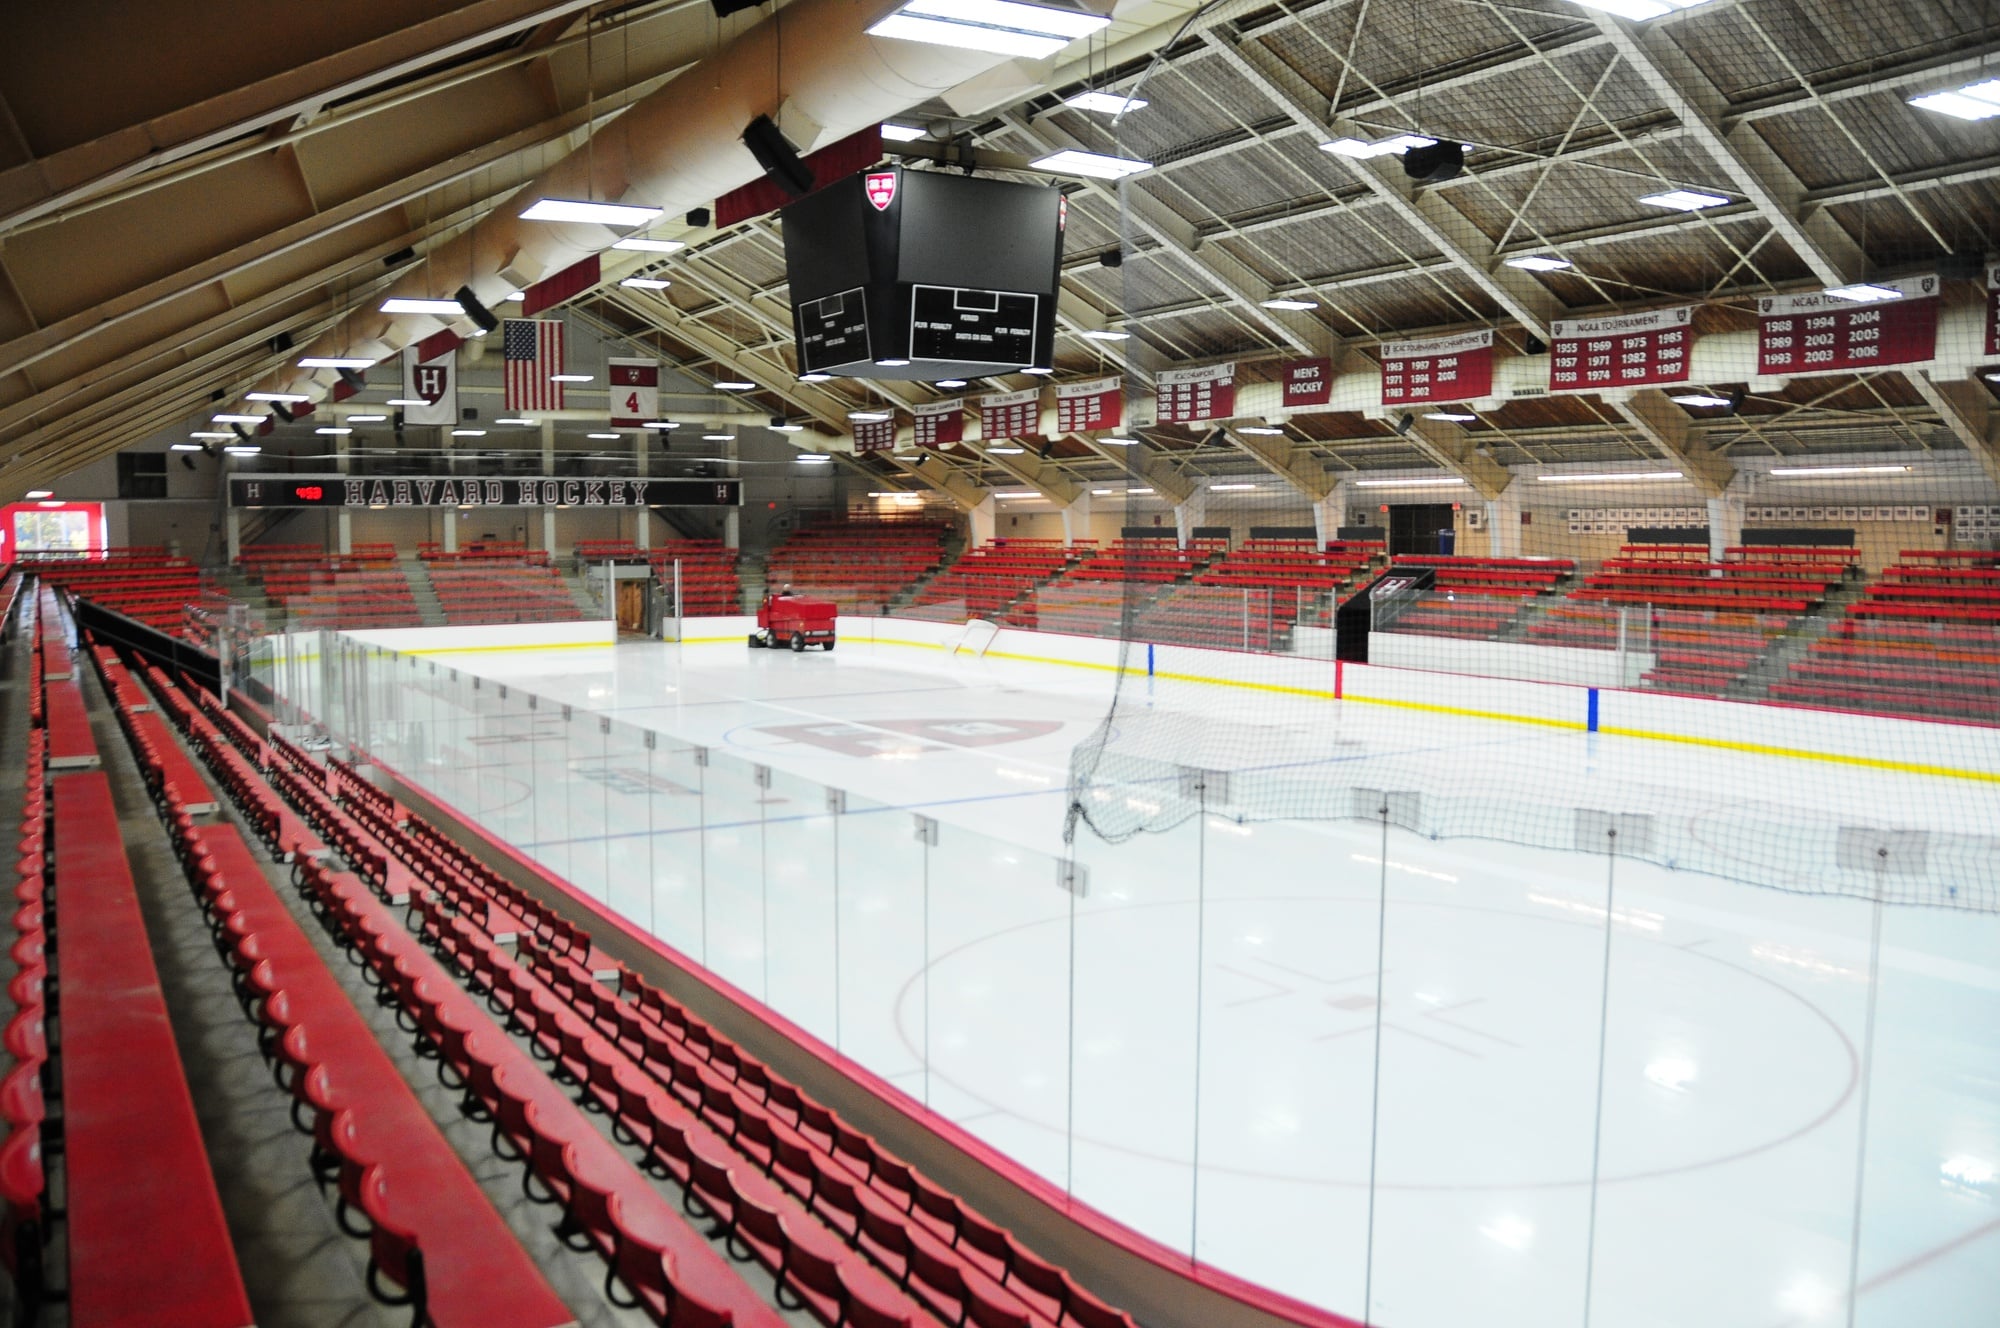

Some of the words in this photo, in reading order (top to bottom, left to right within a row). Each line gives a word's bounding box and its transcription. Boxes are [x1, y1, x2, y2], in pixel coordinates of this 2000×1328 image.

[1792, 294, 1819, 307] NCAA
[1577, 322, 1599, 332] NCAA
[1601, 315, 1659, 331] TOURNAMENT
[1765, 320, 1792, 332] 1988
[1806, 316, 1835, 329] 1994
[1849, 310, 1880, 325] 2004
[1556, 343, 1578, 353] 1955
[1587, 341, 1612, 352] 1969
[1622, 337, 1647, 349] 1975
[1658, 331, 1682, 344] 1985
[1764, 336, 1792, 348] 1989
[1804, 333, 1834, 346] 2002
[1848, 328, 1879, 342] 2005
[1438, 357, 1457, 369] 2004
[1555, 357, 1577, 367] 1957
[1587, 355, 1609, 366] 1971
[1621, 352, 1646, 364] 1982
[1657, 347, 1682, 360] 1986
[1764, 353, 1791, 365] 1993
[1804, 350, 1833, 363] 2003
[1847, 345, 1878, 359] 2006
[421, 369, 439, 395] H
[1293, 366, 1319, 379] MEN'S
[1555, 371, 1577, 382] 1958
[1586, 369, 1610, 380] 1974
[1621, 367, 1646, 378] 1983
[1656, 362, 1681, 374] 1987
[1289, 381, 1322, 394] HOCKEY
[1410, 387, 1429, 397] 2002
[626, 391, 639, 413] 4
[247, 483, 260, 498] H
[344, 480, 503, 505] HARVARD
[519, 481, 648, 505] HOCKEY
[717, 485, 727, 498] H
